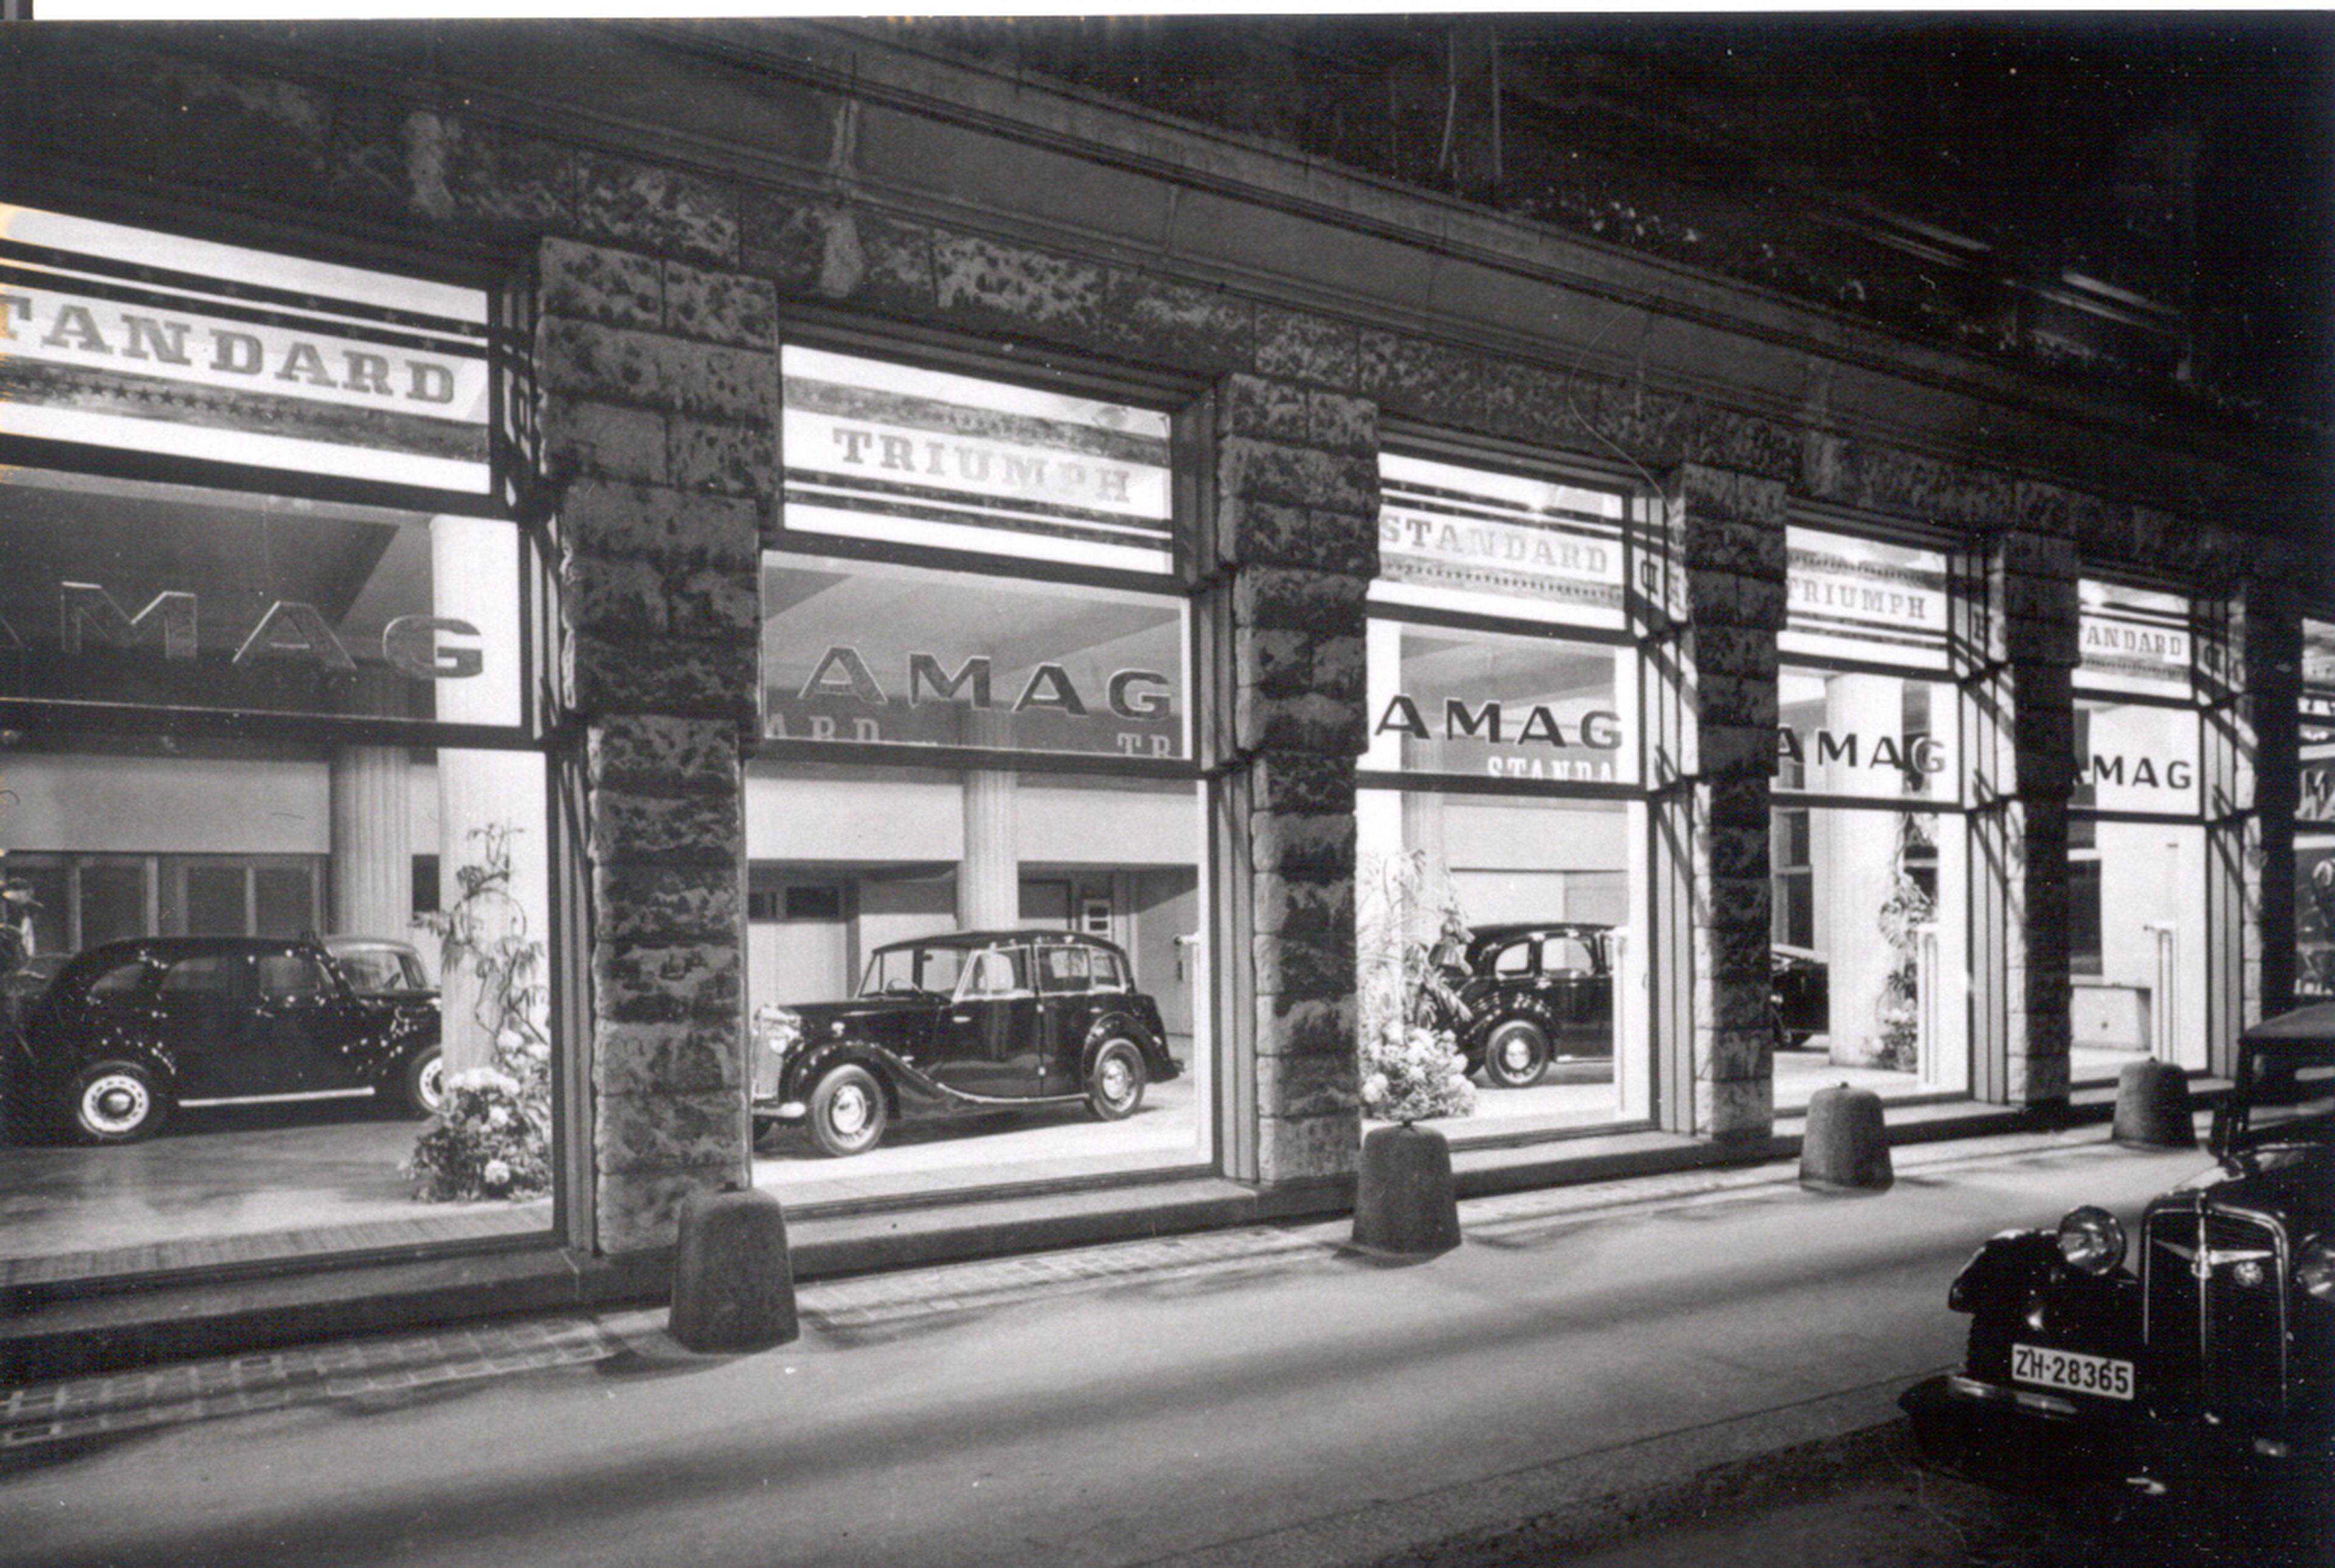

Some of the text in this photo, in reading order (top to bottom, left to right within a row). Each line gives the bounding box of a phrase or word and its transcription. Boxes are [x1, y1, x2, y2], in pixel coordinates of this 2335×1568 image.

[833, 426, 1131, 504] TRIUMPH
[1380, 514, 1607, 574] STANDARD
[2080, 624, 2182, 656] ANDARD
[798, 644, 1172, 722] AMAG
[1374, 693, 1623, 751] AMAG
[1778, 724, 1946, 774] AMAG
[2073, 754, 2191, 790] MAG
